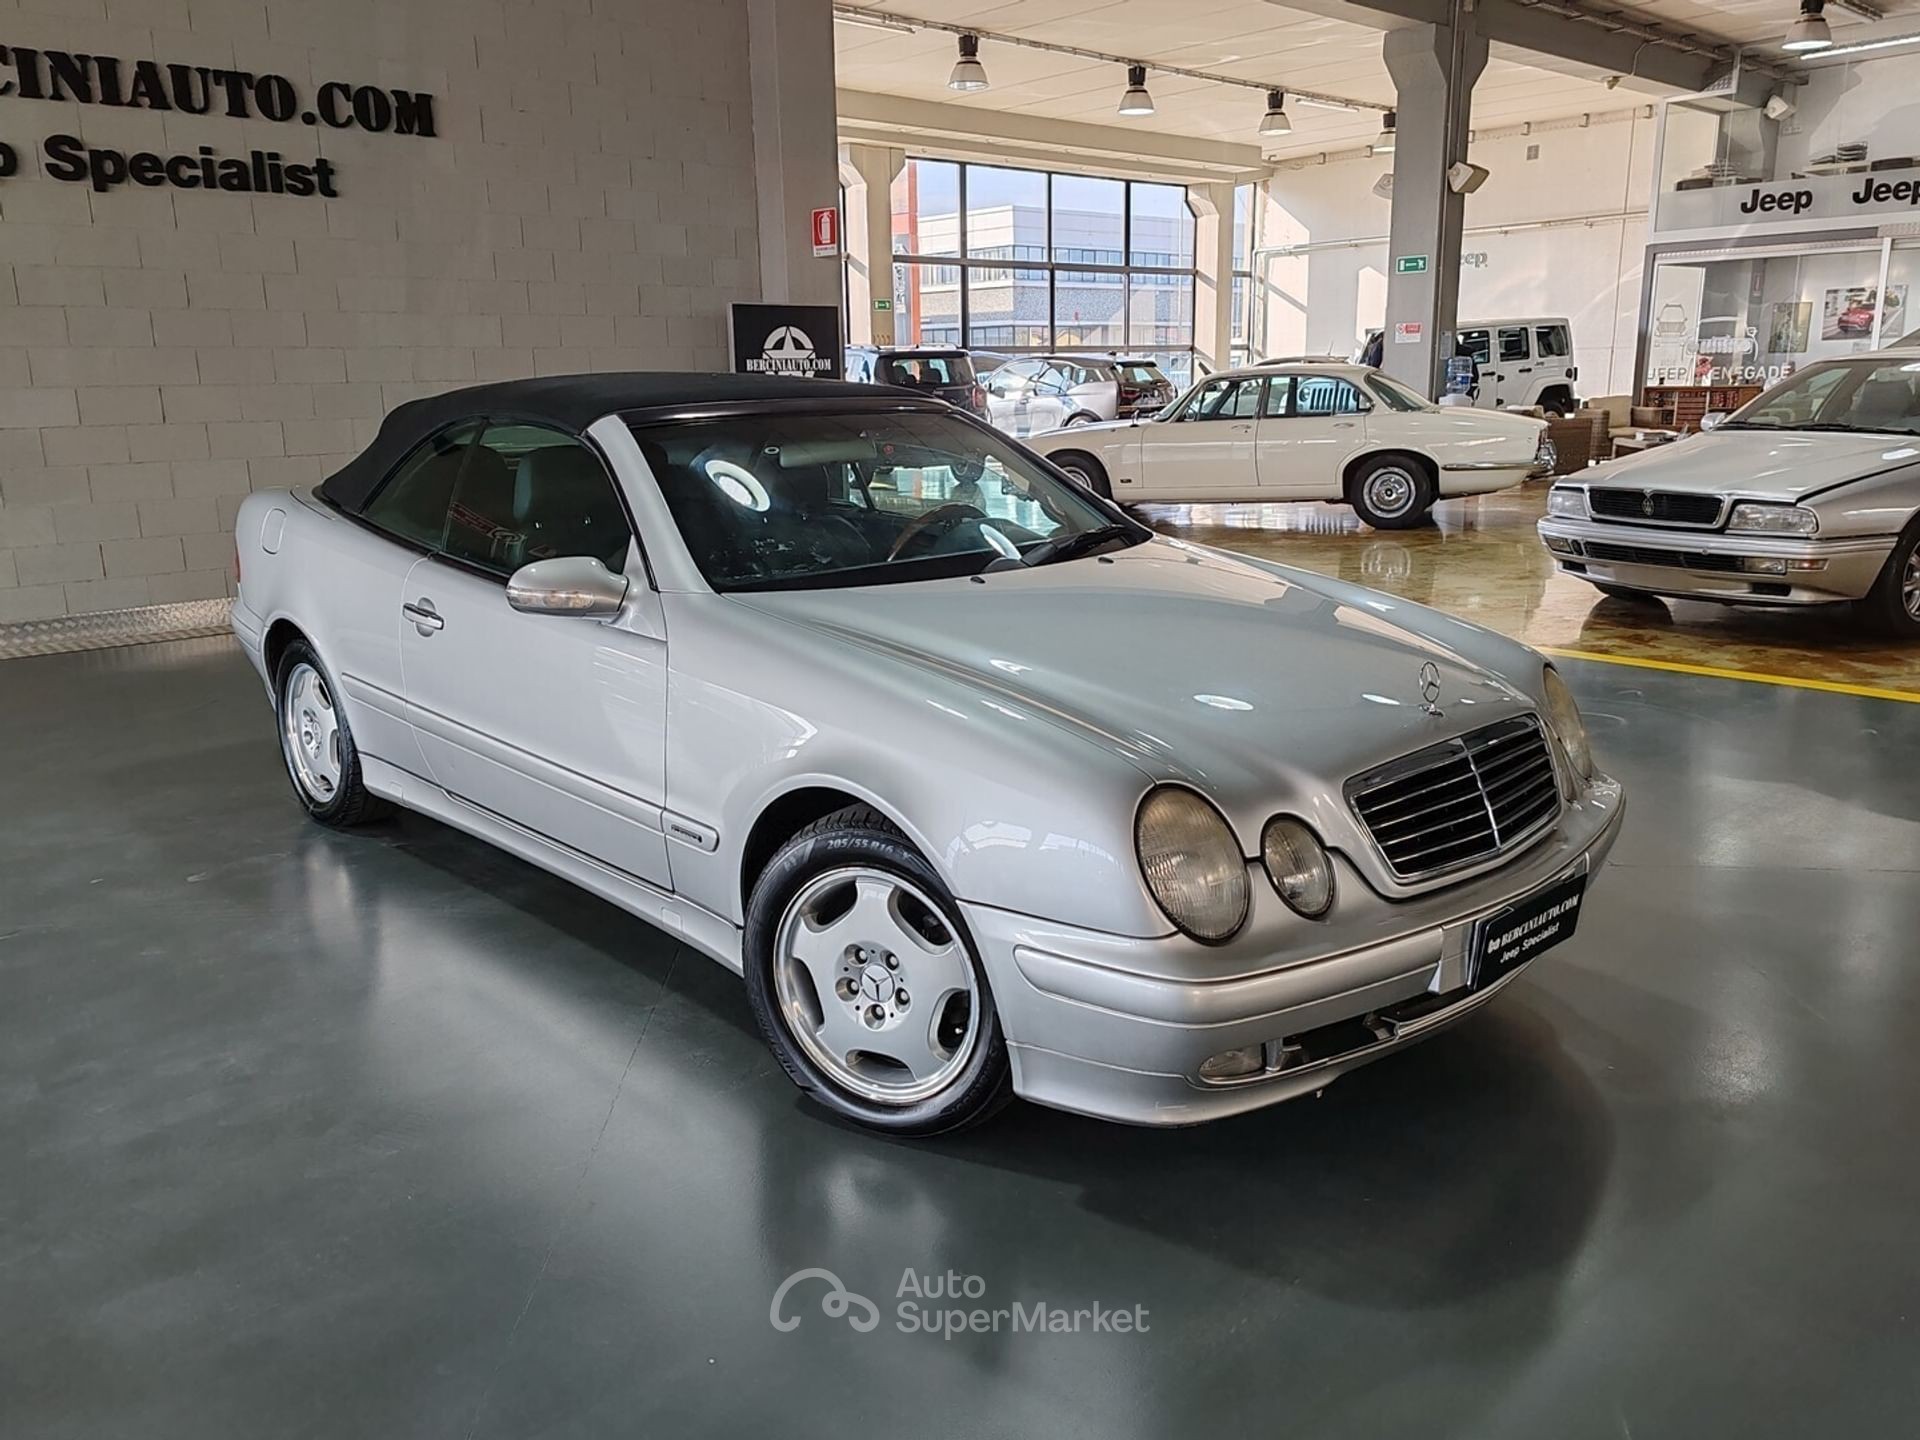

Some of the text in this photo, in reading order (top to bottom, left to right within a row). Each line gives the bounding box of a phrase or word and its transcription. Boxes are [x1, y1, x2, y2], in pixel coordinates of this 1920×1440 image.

[44, 134, 338, 198] Specialist
[1740, 189, 1813, 214] Jeep
[746, 358, 832, 371] BERCINIAUTO.COM
[1698, 365, 1792, 380] ENEGADE
[827, 838, 869, 850] 205/55
[1500, 922, 1560, 963] Jeep Specialist
